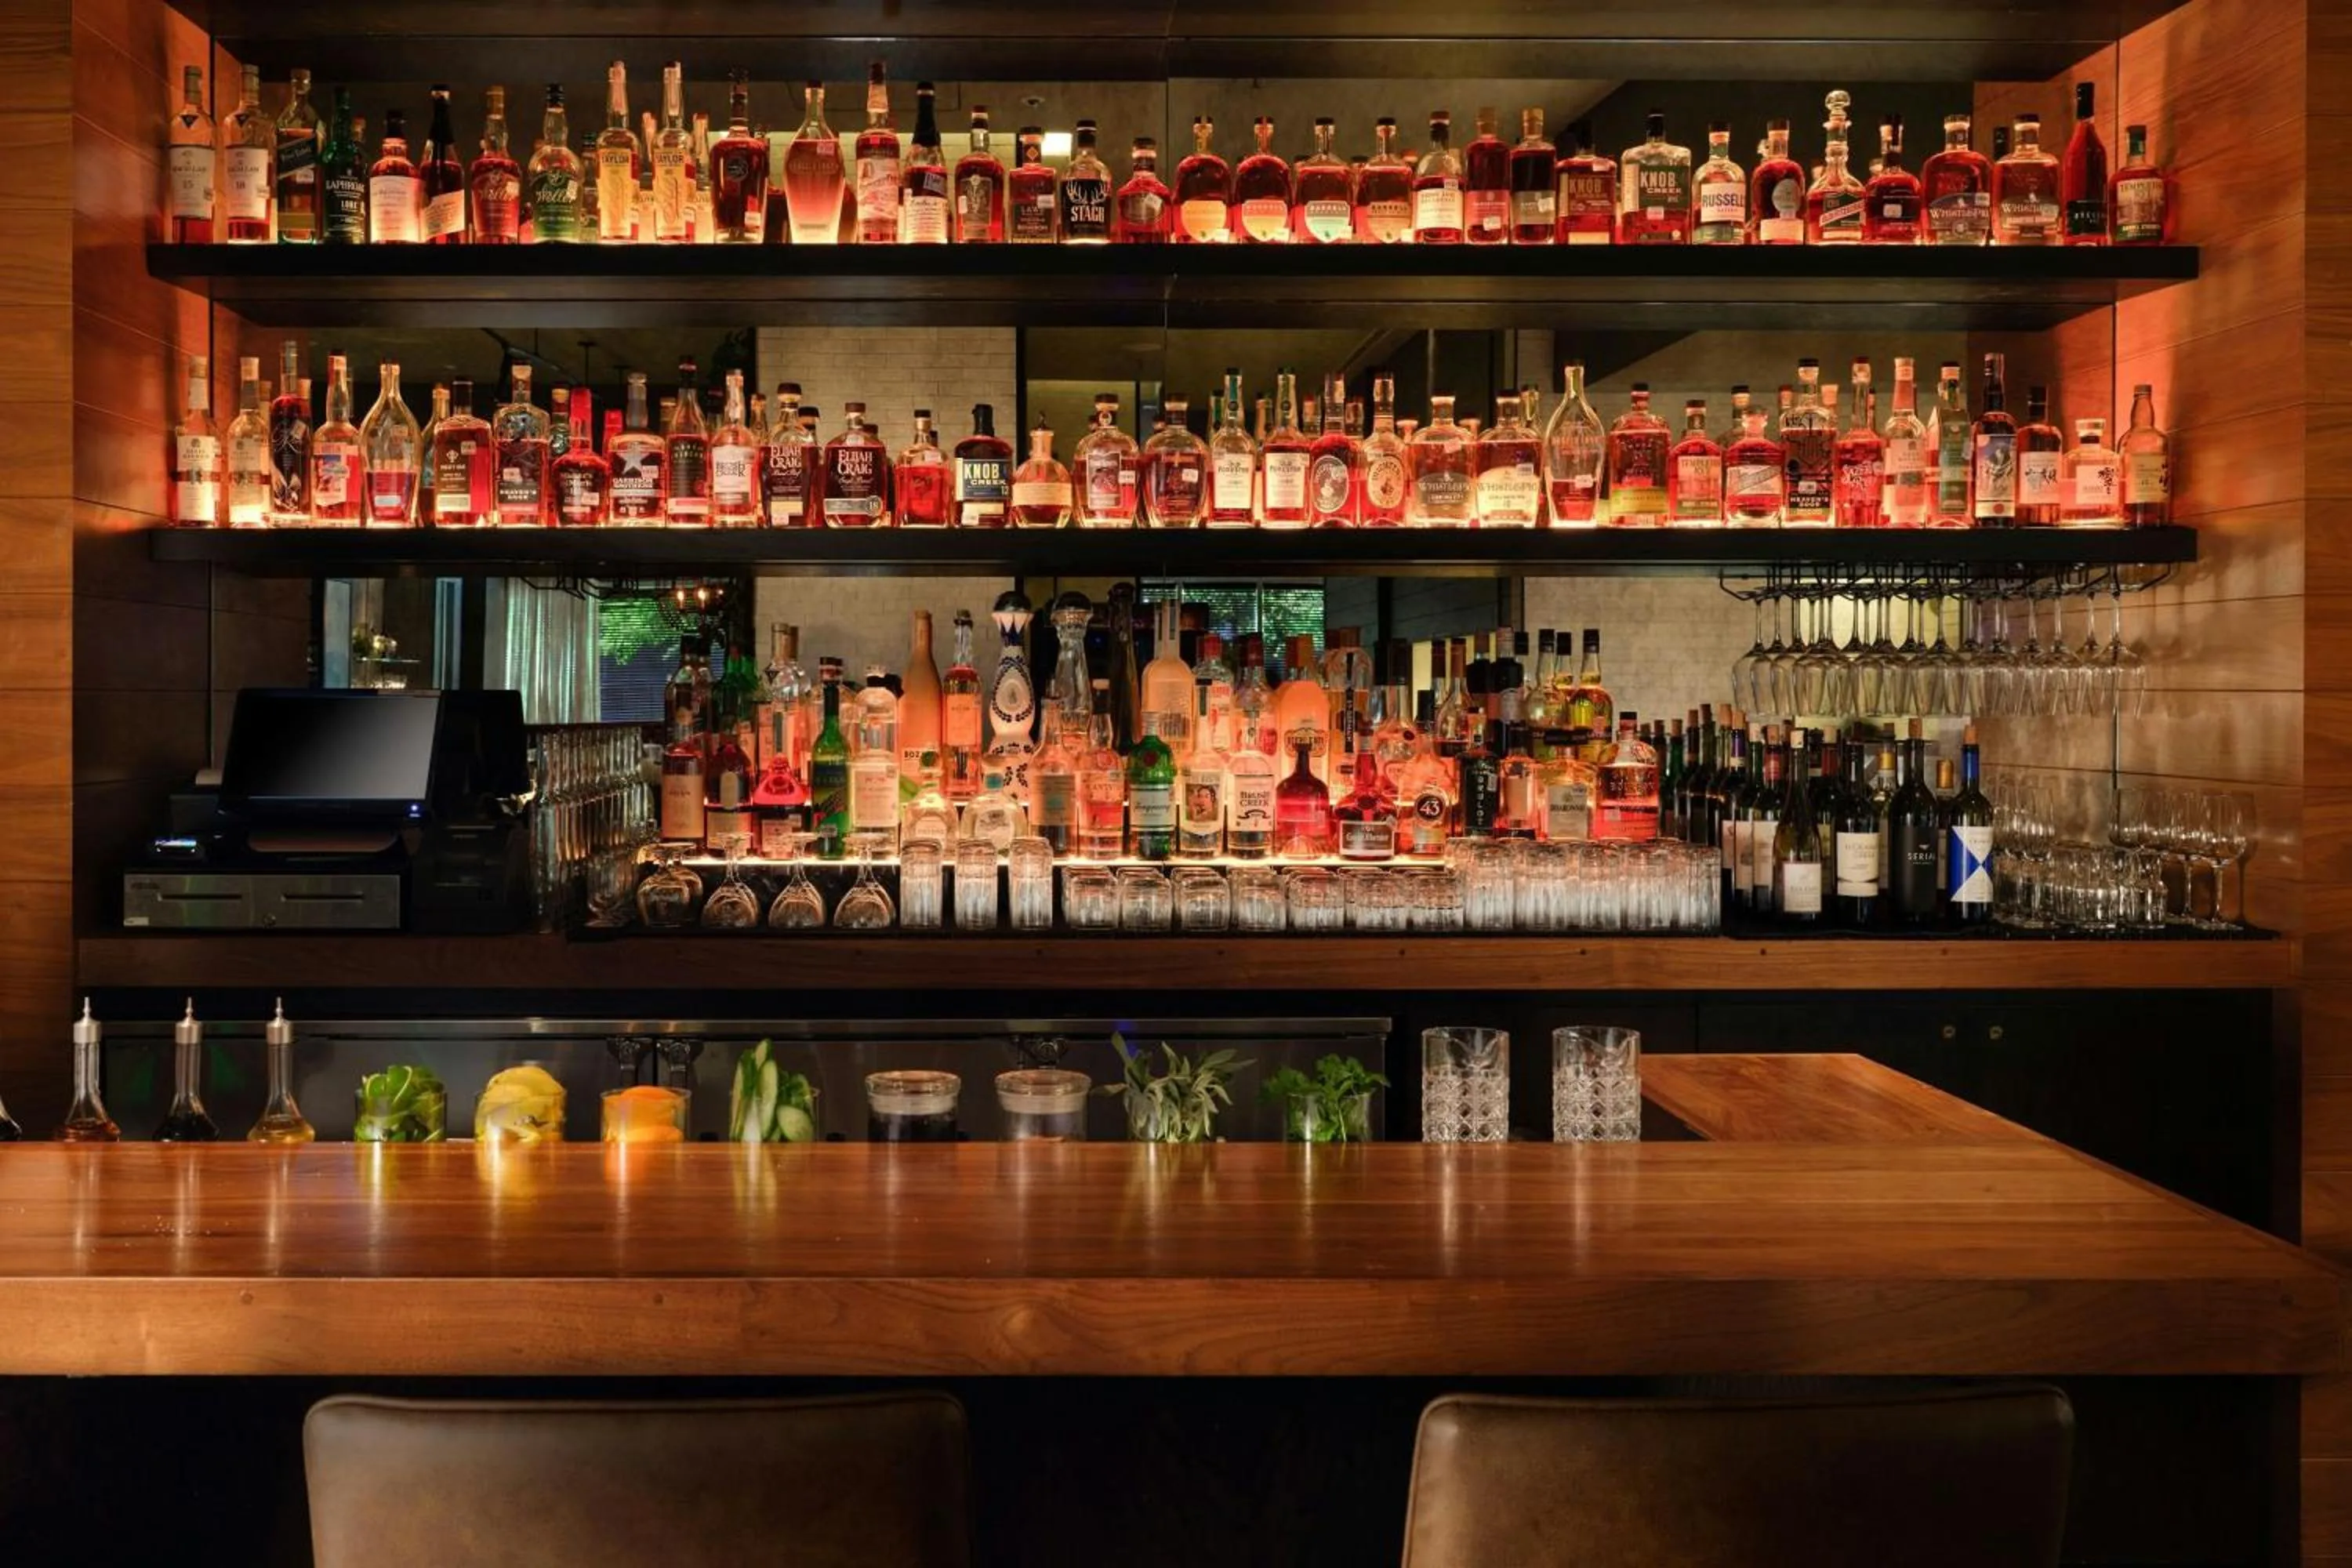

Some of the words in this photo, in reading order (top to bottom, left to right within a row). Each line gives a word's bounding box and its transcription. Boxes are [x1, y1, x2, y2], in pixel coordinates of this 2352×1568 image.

[1569, 179, 1602, 194] KNOB
[1640, 172, 1675, 187] KNOB
[1071, 205, 1105, 223] STAGG
[771, 444, 801, 456] ELIJAH
[839, 449, 873, 461] ELIJAH
[770, 456, 801, 468] CRAIG
[837, 462, 873, 475] CRAIG
[964, 463, 1000, 479] KNOB
[1420, 800, 1441, 816] 43
